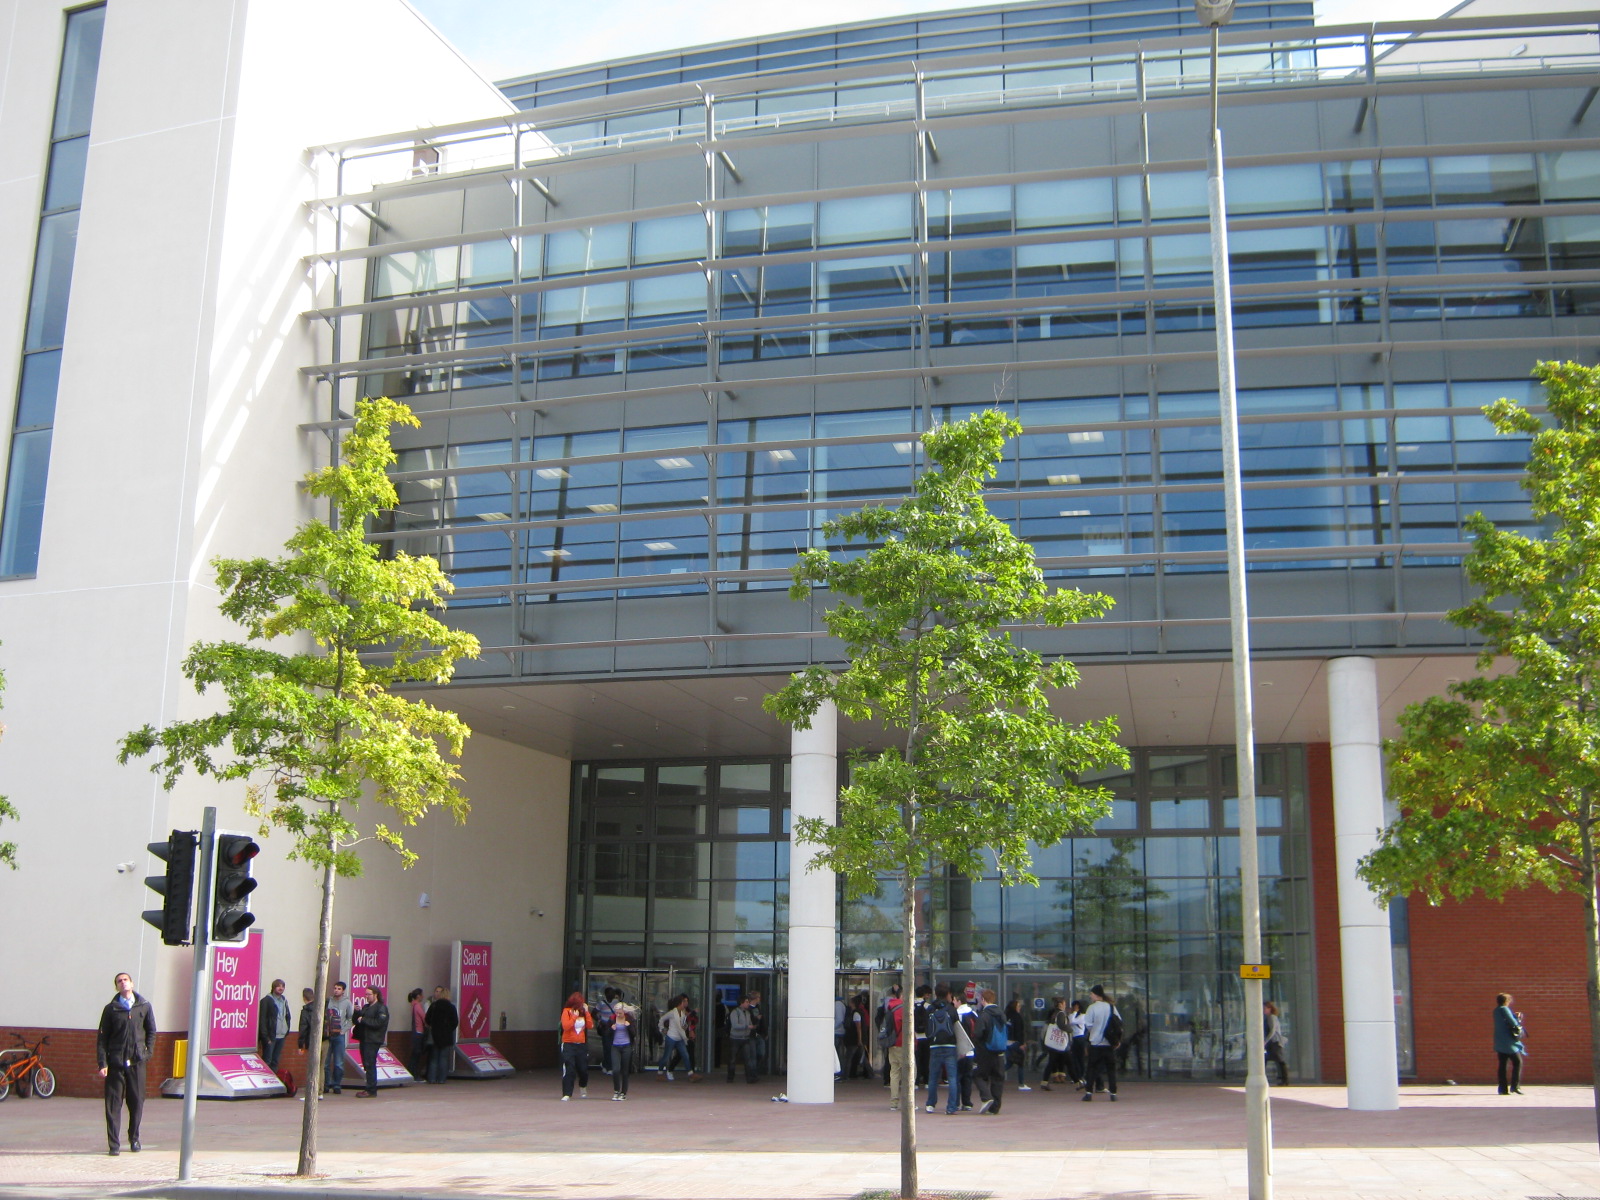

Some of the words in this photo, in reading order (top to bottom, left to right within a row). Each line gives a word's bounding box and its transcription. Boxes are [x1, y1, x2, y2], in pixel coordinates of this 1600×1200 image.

[216, 951, 239, 977] Hey
[353, 948, 378, 968] What
[463, 948, 481, 966] Save
[482, 949, 488, 966] it
[352, 973, 368, 988] are
[370, 973, 386, 988] you
[462, 969, 484, 986] with...
[214, 979, 256, 1005] Smarty
[213, 1008, 248, 1029] Pants!
